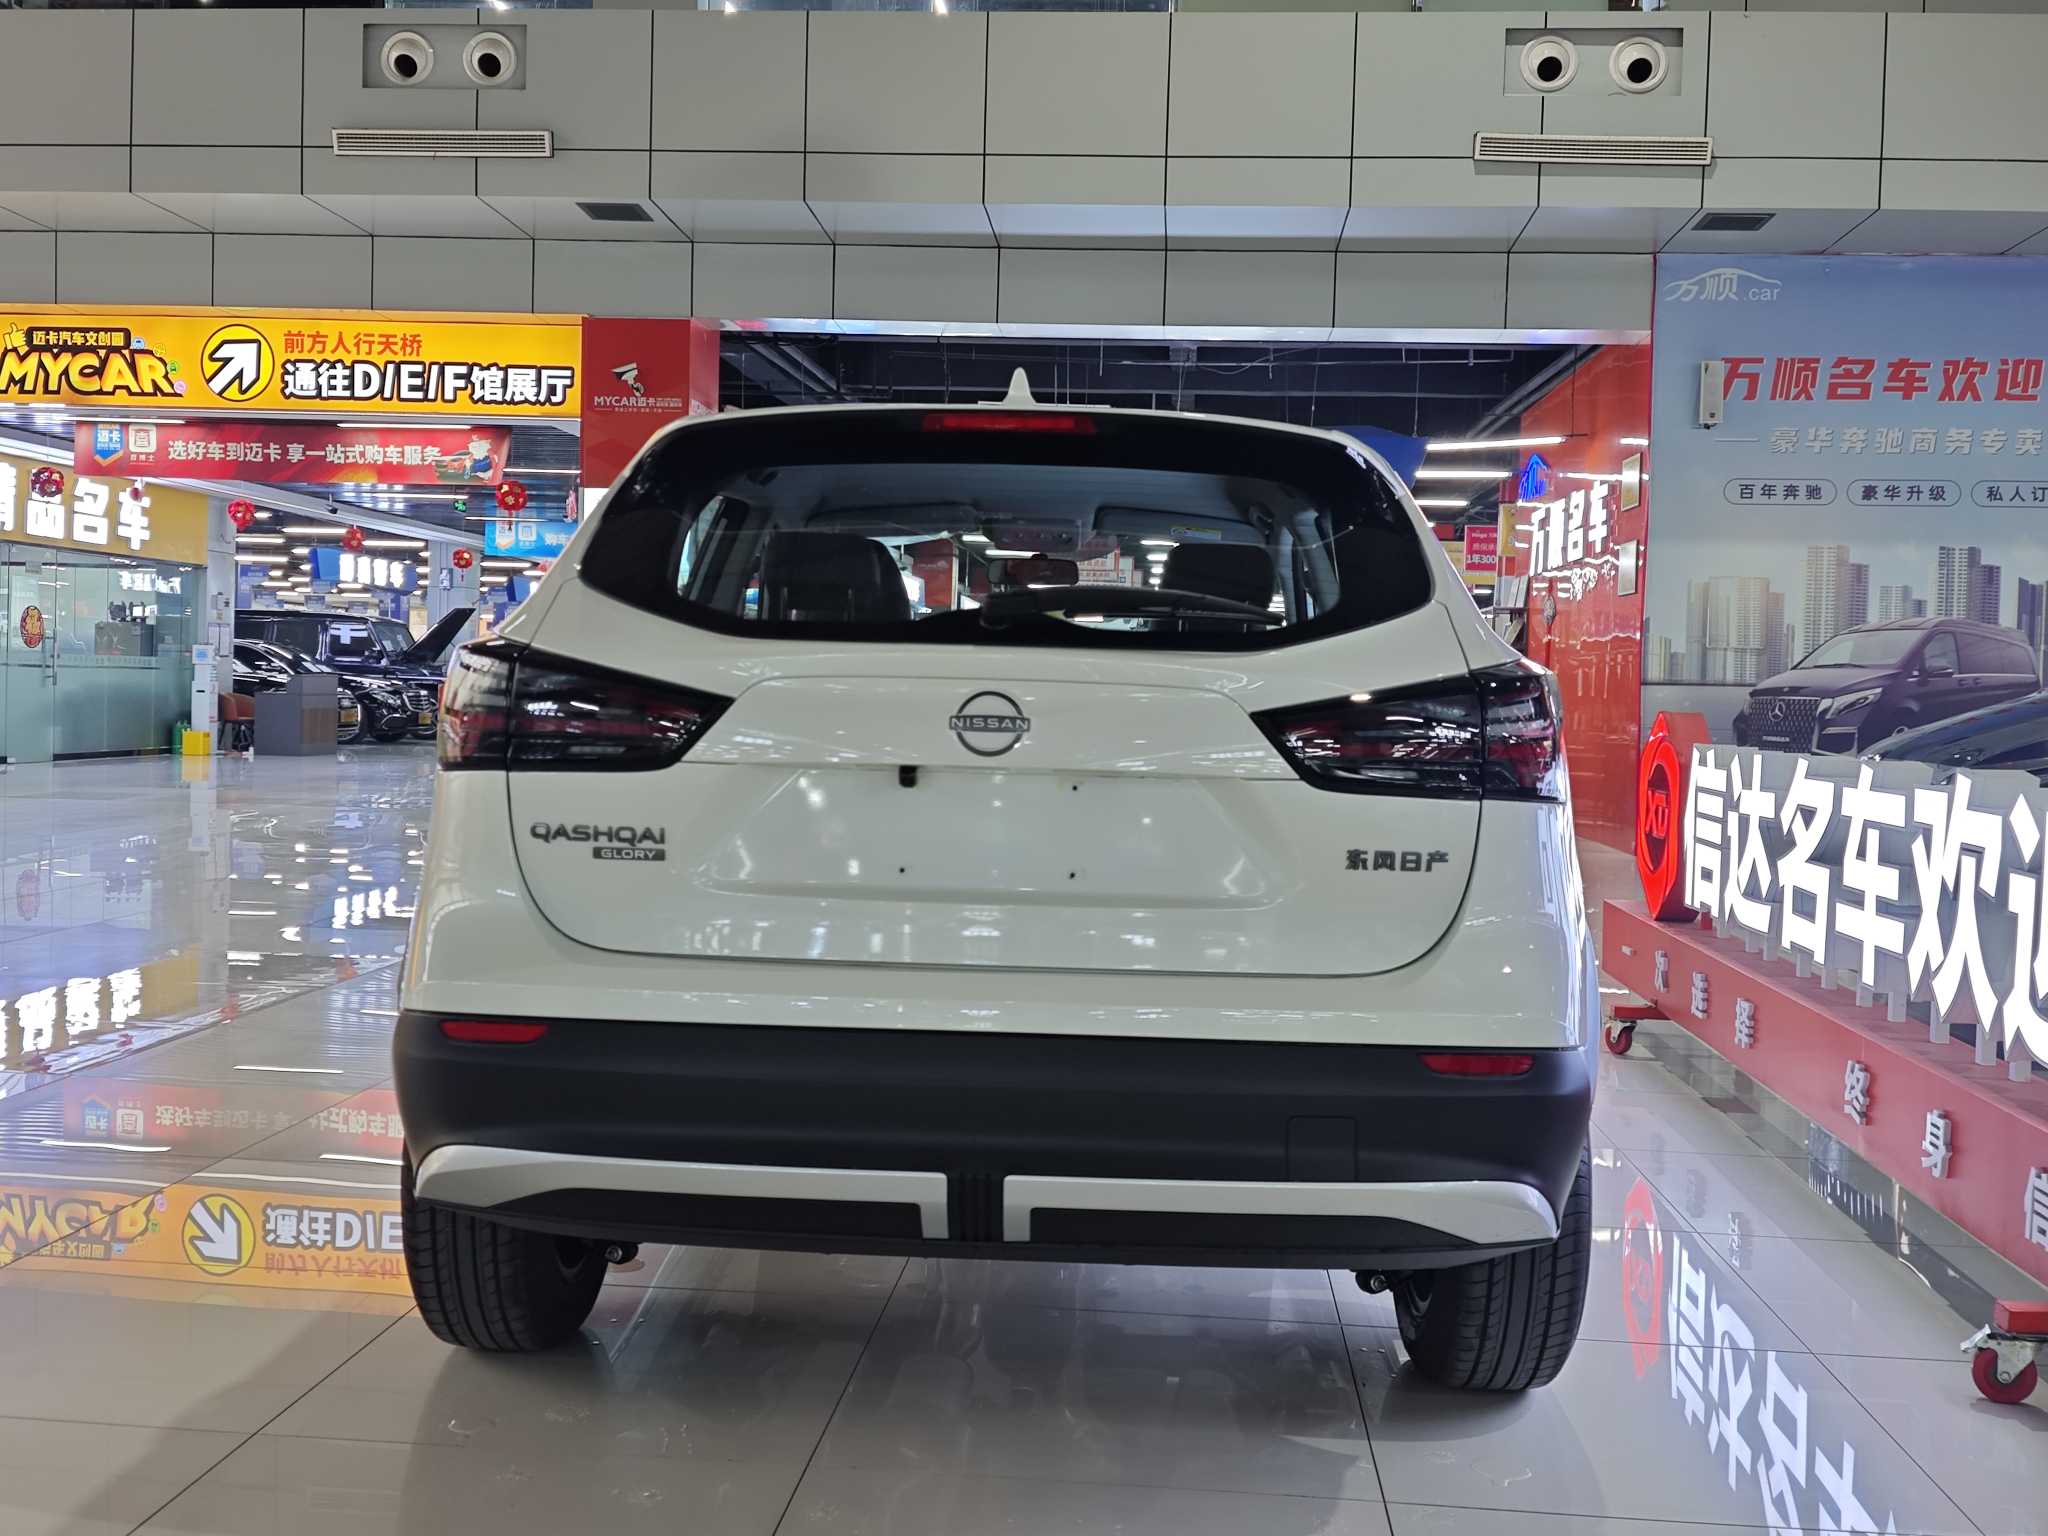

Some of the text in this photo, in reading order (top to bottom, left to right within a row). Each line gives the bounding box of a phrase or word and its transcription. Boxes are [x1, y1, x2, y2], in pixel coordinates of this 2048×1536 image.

[284, 331, 422, 357] 前方人行天桥
[0, 350, 180, 396] MYCAR
[283, 360, 573, 404] 通往D/E/F馆展厅
[1720, 356, 2044, 402] 万顺名车欢迎
[168, 440, 441, 466] 选好车到迈卡 享一站式购车服务
[1738, 483, 1823, 501] 百年奔驰
[1860, 485, 1947, 502] 豪华升级
[950, 716, 1029, 731] NISSAN
[530, 822, 665, 846] QASHQAI
[599, 848, 658, 860] GLORY
[1345, 849, 1449, 872] 东风日产
